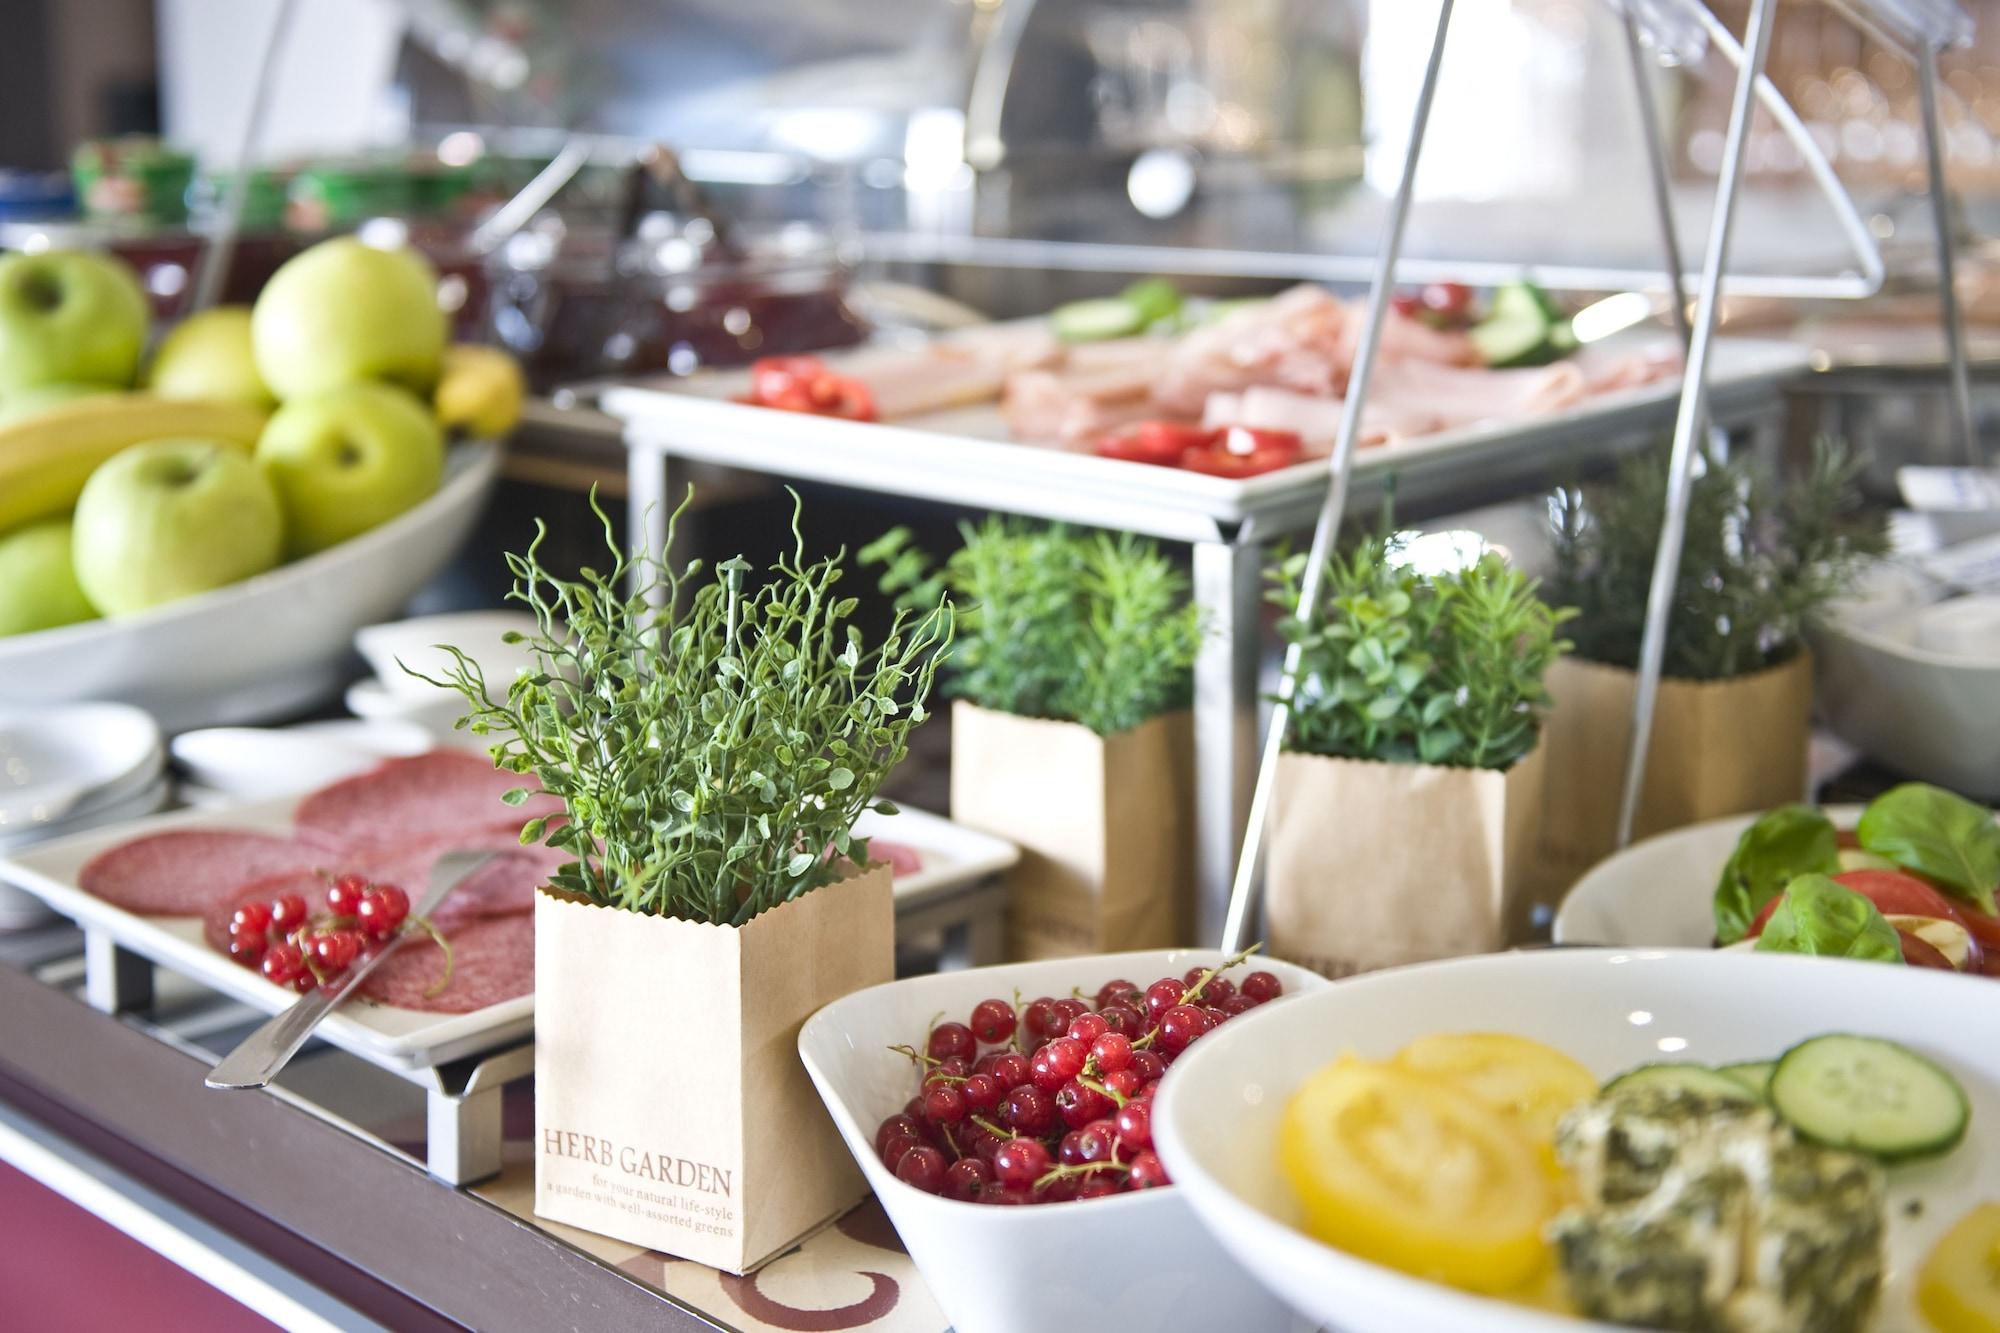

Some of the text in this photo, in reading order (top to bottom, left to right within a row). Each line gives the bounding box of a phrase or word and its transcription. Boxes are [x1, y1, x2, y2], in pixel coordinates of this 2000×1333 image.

[544, 1129, 732, 1198] HERB GARDEN
[548, 1183, 734, 1237] a garden with well-assorted greens
[592, 1174, 733, 1221] for your natural life-style
